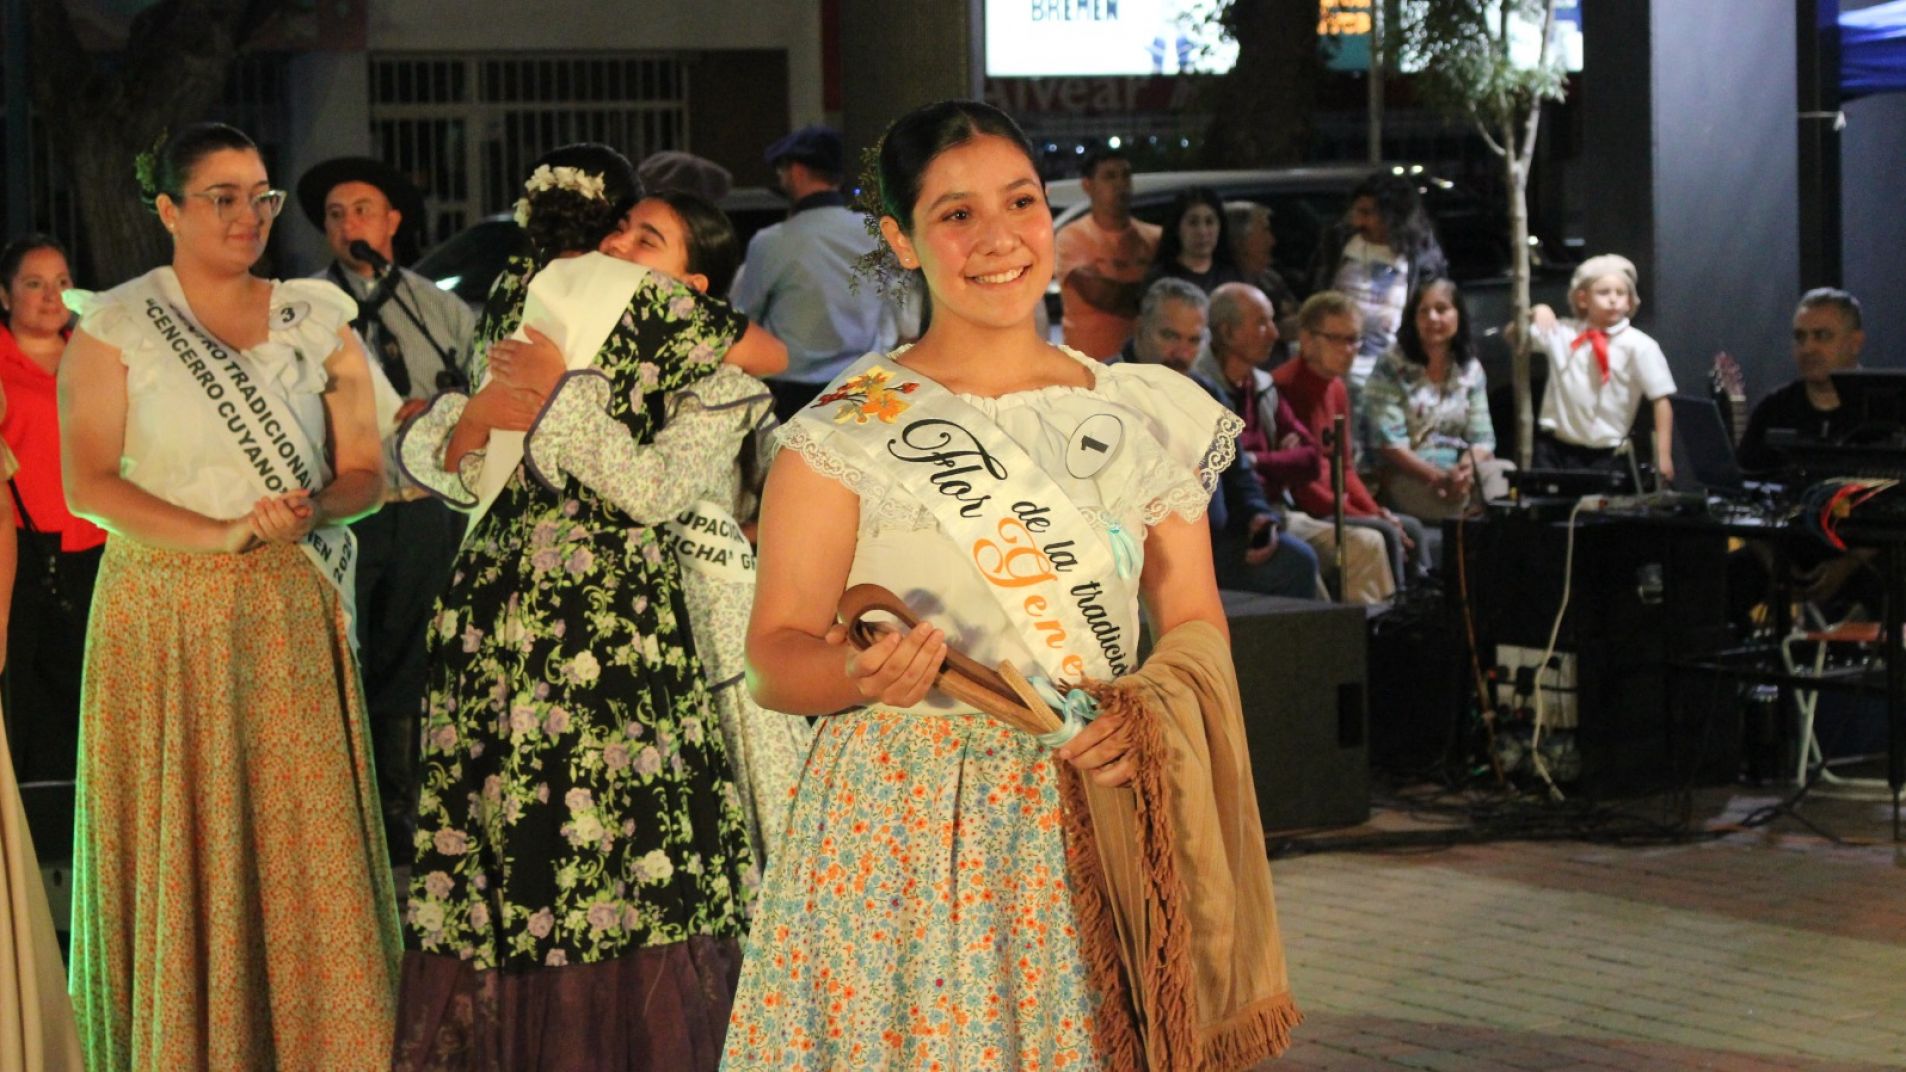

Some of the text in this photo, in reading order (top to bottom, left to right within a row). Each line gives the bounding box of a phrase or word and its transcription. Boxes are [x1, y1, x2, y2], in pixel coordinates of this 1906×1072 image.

[281, 307, 295, 324] 3
[1081, 435, 1110, 454] 1
[887, 418, 1008, 518] Flor
[1011, 501, 1051, 534] de
[1043, 540, 1078, 572] la
